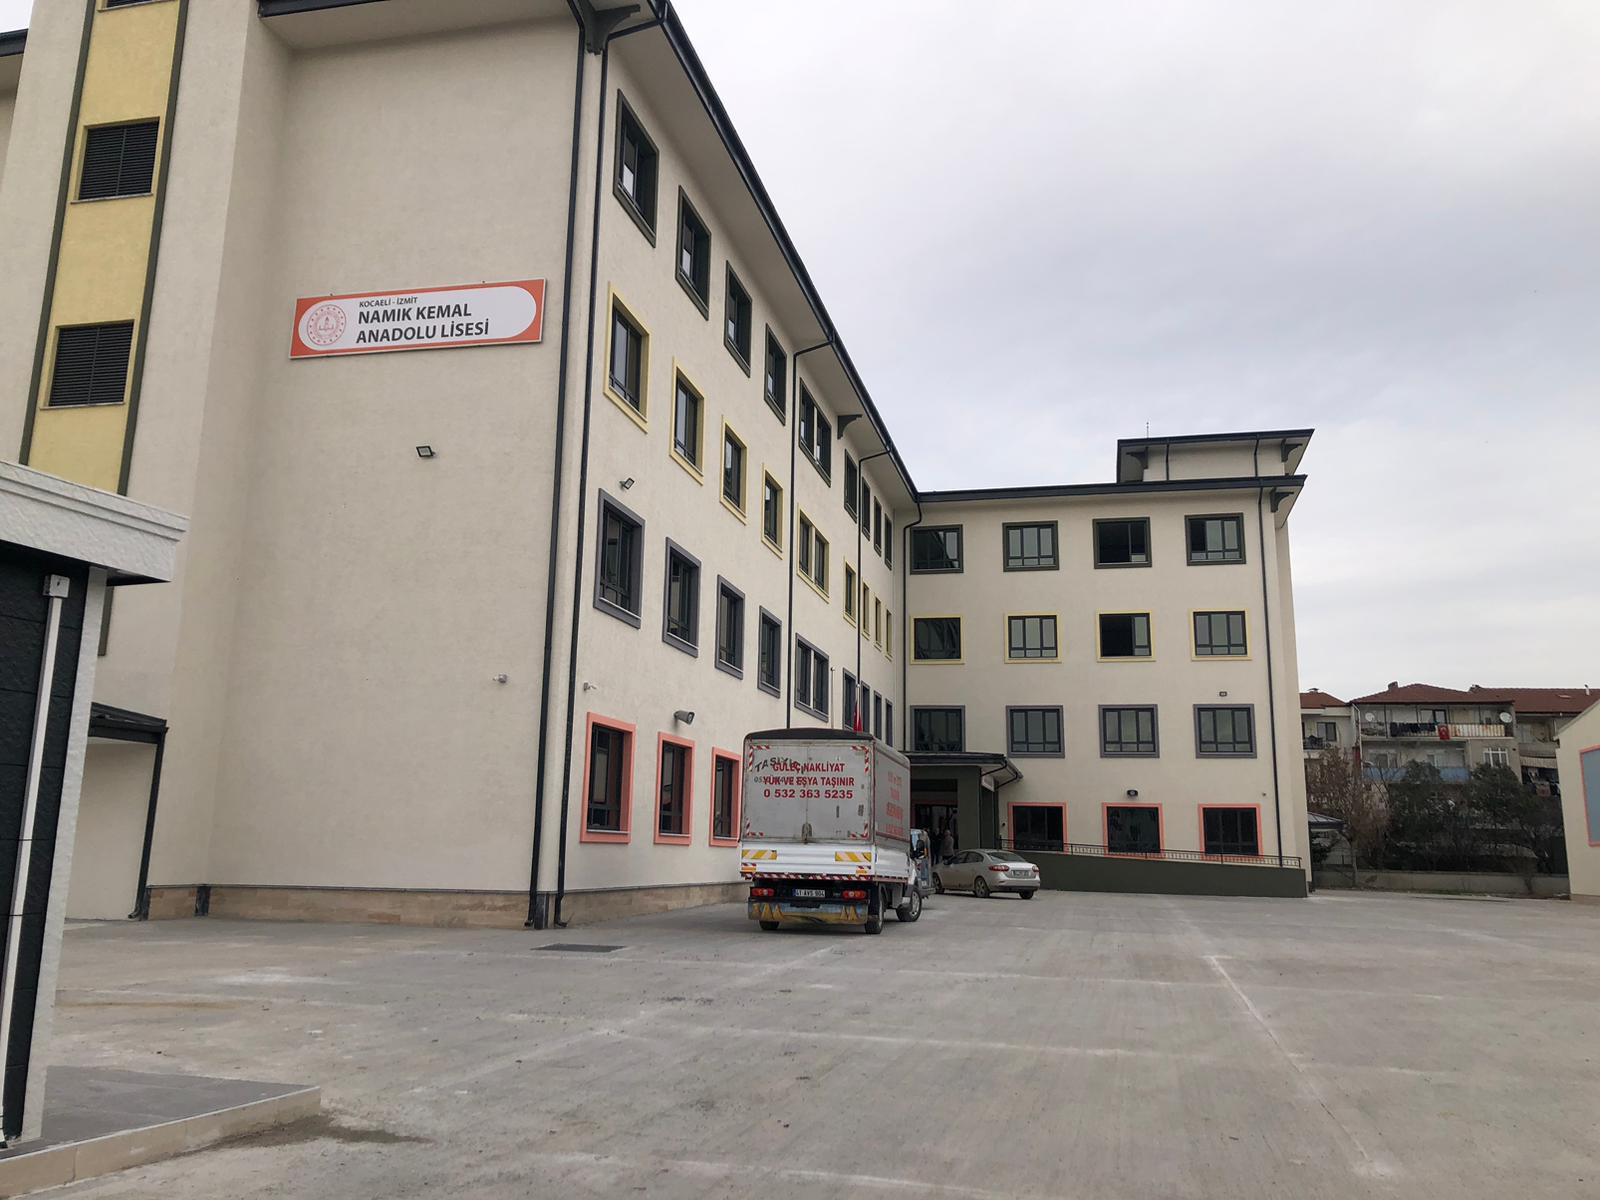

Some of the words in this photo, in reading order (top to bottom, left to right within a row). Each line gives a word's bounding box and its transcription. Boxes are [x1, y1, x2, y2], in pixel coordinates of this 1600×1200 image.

[359, 298, 391, 308] KOCAELİ
[396, 296, 418, 305] İZMİT
[358, 307, 413, 324] NAMIK
[416, 303, 472, 320] KEMAL
[356, 325, 437, 344] ANADOLU
[440, 318, 489, 338] LİSESİ
[803, 760, 846, 772] NAKLİYAT
[783, 776, 794, 786] VE
[820, 776, 855, 788] TAŞINIR
[763, 789, 771, 798] 0
[774, 789, 796, 798] 532
[799, 789, 820, 798] 363
[824, 789, 853, 799] 5235
